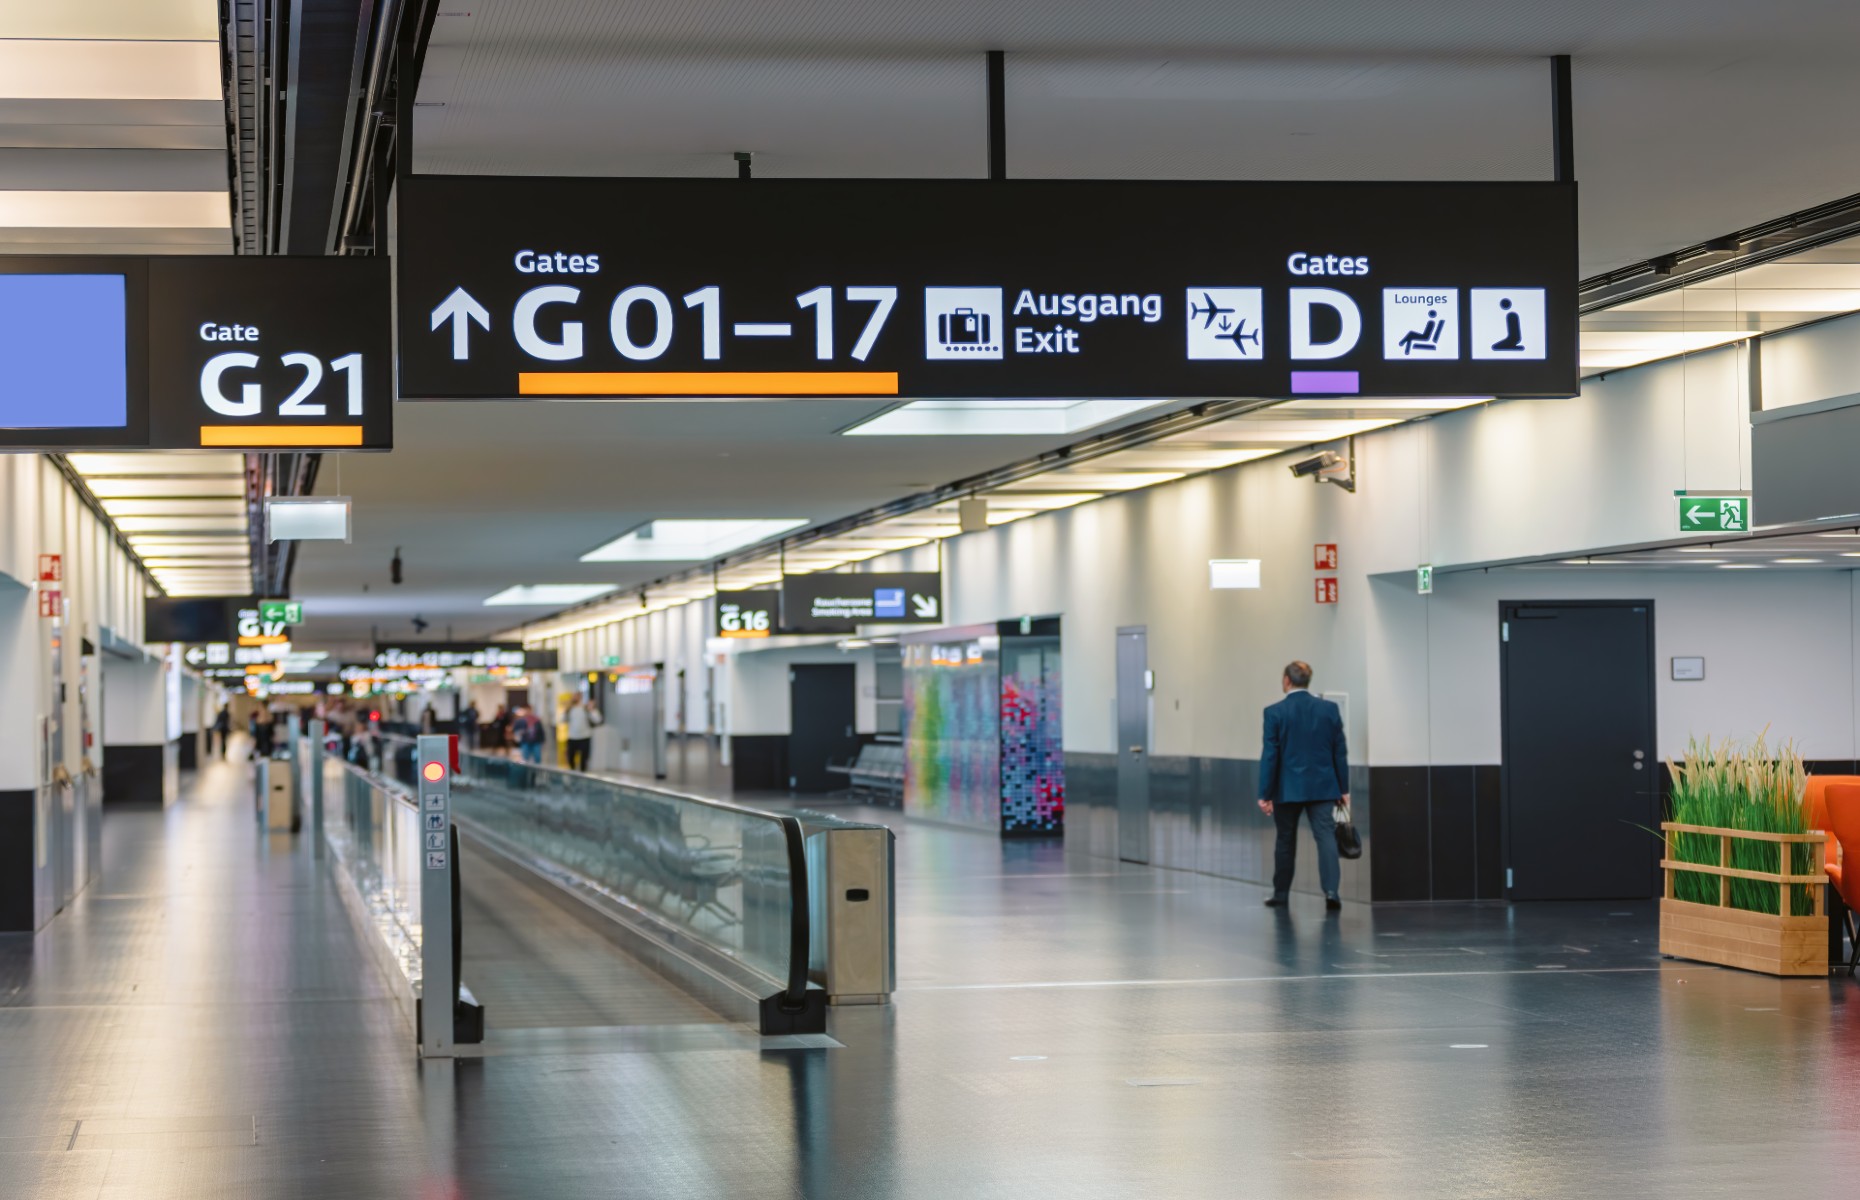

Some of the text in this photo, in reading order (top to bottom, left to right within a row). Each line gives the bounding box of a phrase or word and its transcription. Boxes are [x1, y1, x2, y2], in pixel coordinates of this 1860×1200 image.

[514, 250, 600, 273] Gates
[1287, 252, 1369, 276] Gates
[1013, 290, 1162, 323] Ausgang
[1394, 293, 1448, 307] Lounges
[199, 322, 260, 342] Gate
[513, 285, 583, 361] G
[1289, 287, 1362, 360] D
[1015, 324, 1080, 353] Exit
[200, 352, 363, 417] G 21
[720, 610, 770, 631] G 16
